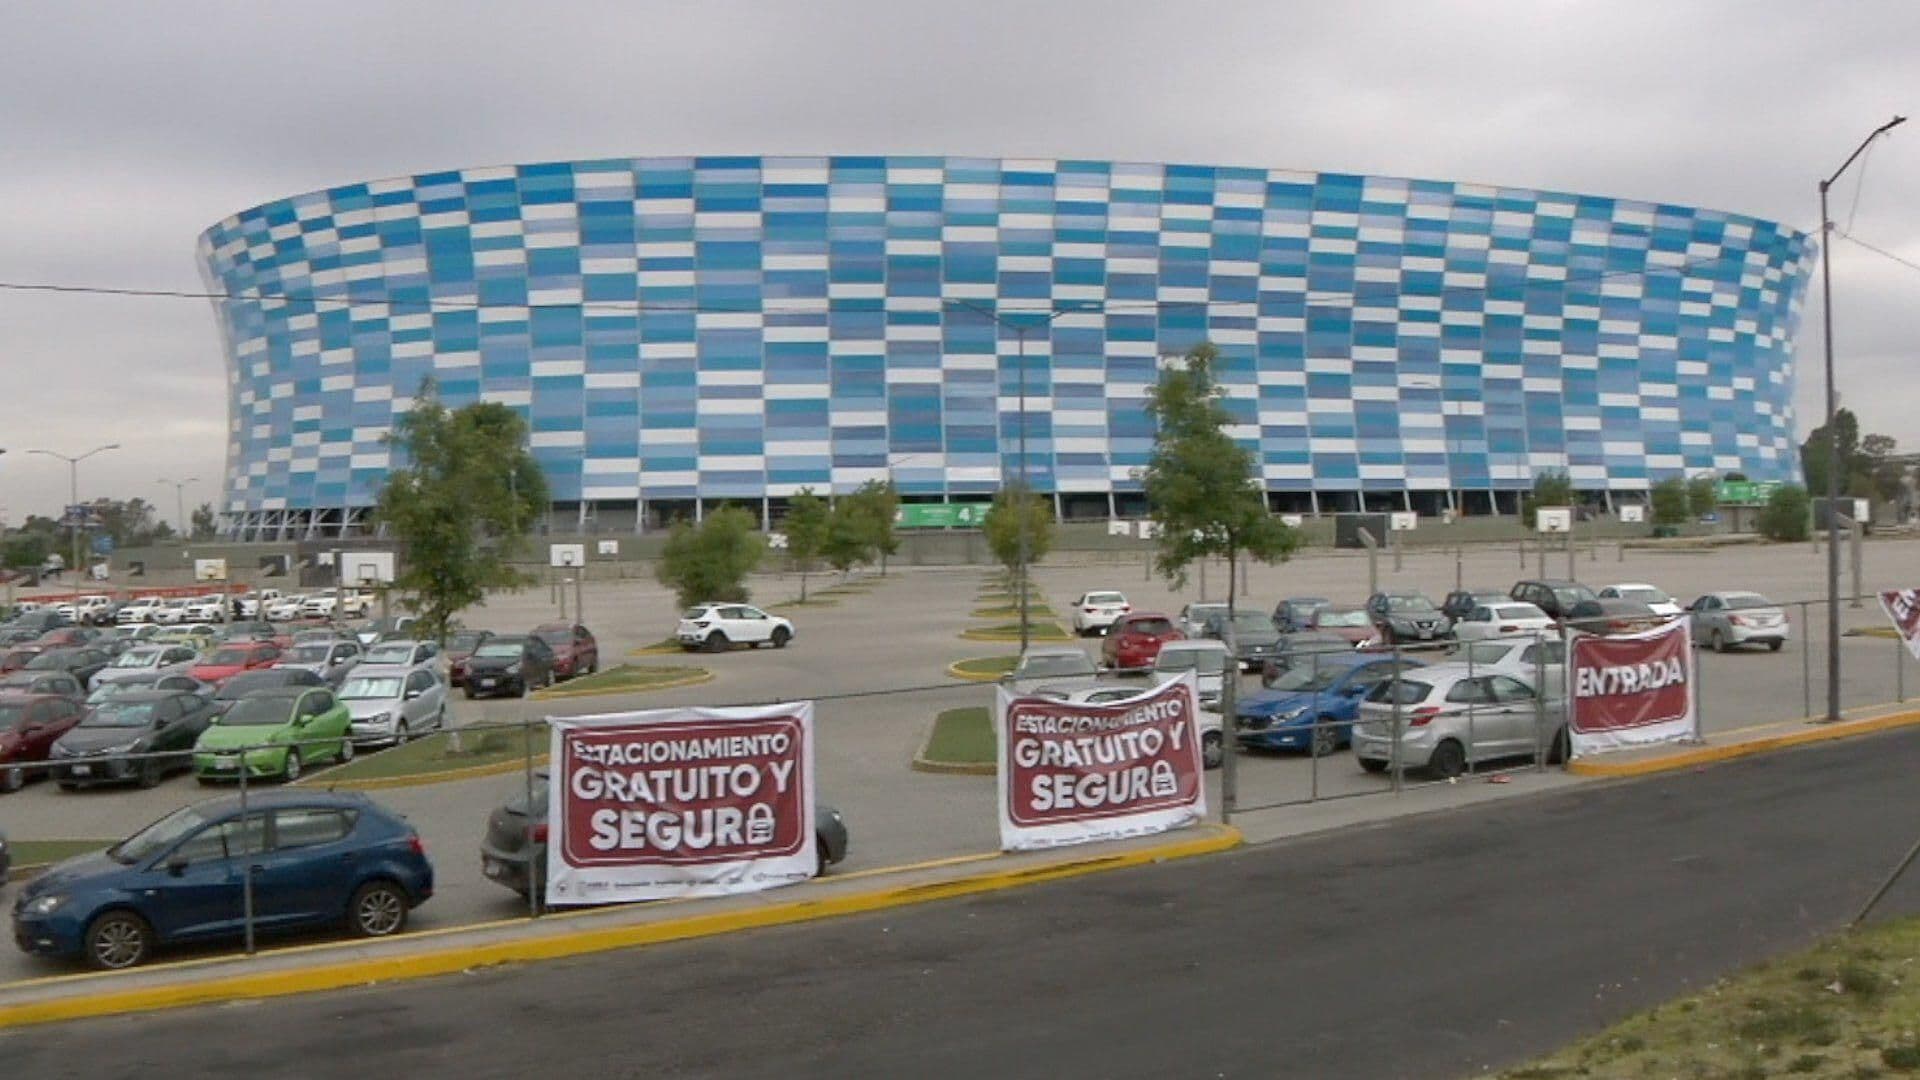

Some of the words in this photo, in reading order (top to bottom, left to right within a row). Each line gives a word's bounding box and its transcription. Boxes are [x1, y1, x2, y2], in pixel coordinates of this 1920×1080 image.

[1576, 657, 1685, 697] ENTRADA
[1015, 729, 1163, 768] GRATUITO
[1170, 721, 1186, 750] Y
[572, 763, 761, 802] GRATUITO
[769, 759, 794, 793] Y
